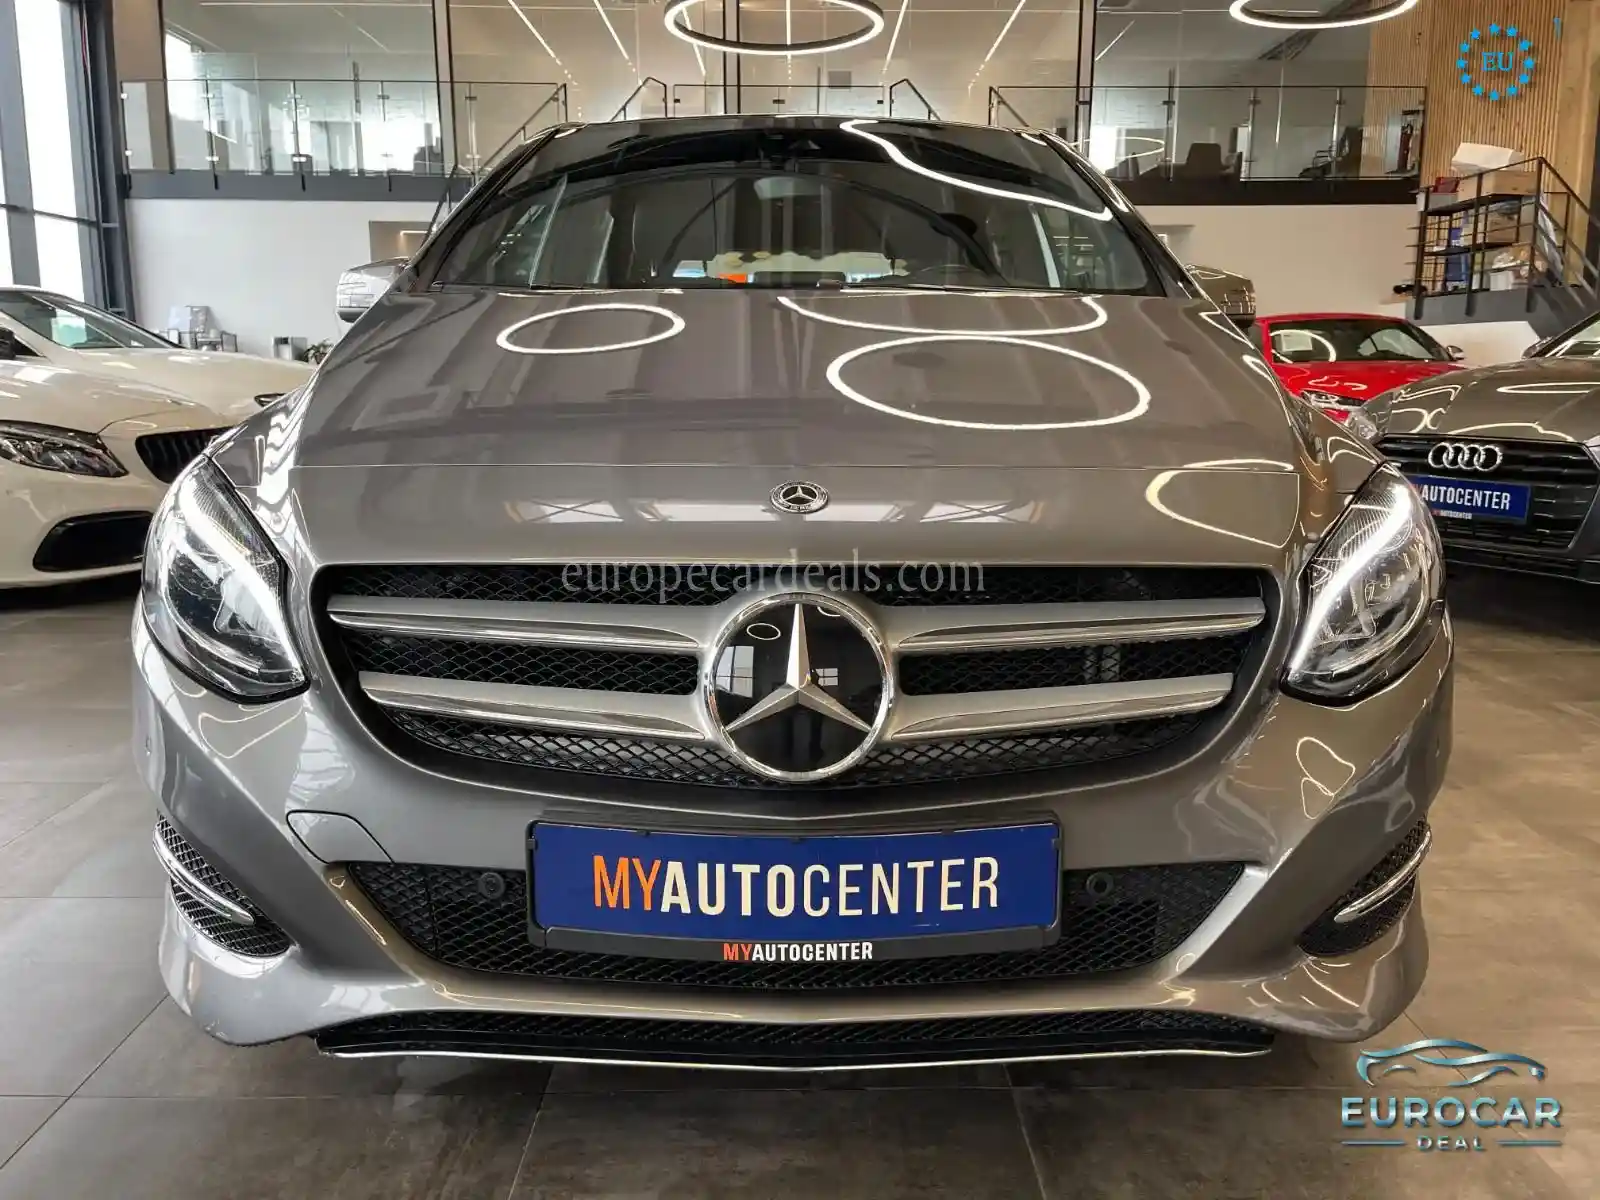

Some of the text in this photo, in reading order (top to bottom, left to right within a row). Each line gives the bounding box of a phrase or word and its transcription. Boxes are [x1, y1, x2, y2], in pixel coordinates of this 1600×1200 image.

[1409, 484, 1511, 510] AUTOCENTER
[593, 855, 999, 917] MYAUTOCENTER
[722, 942, 874, 963] MYAUTOCENTER
